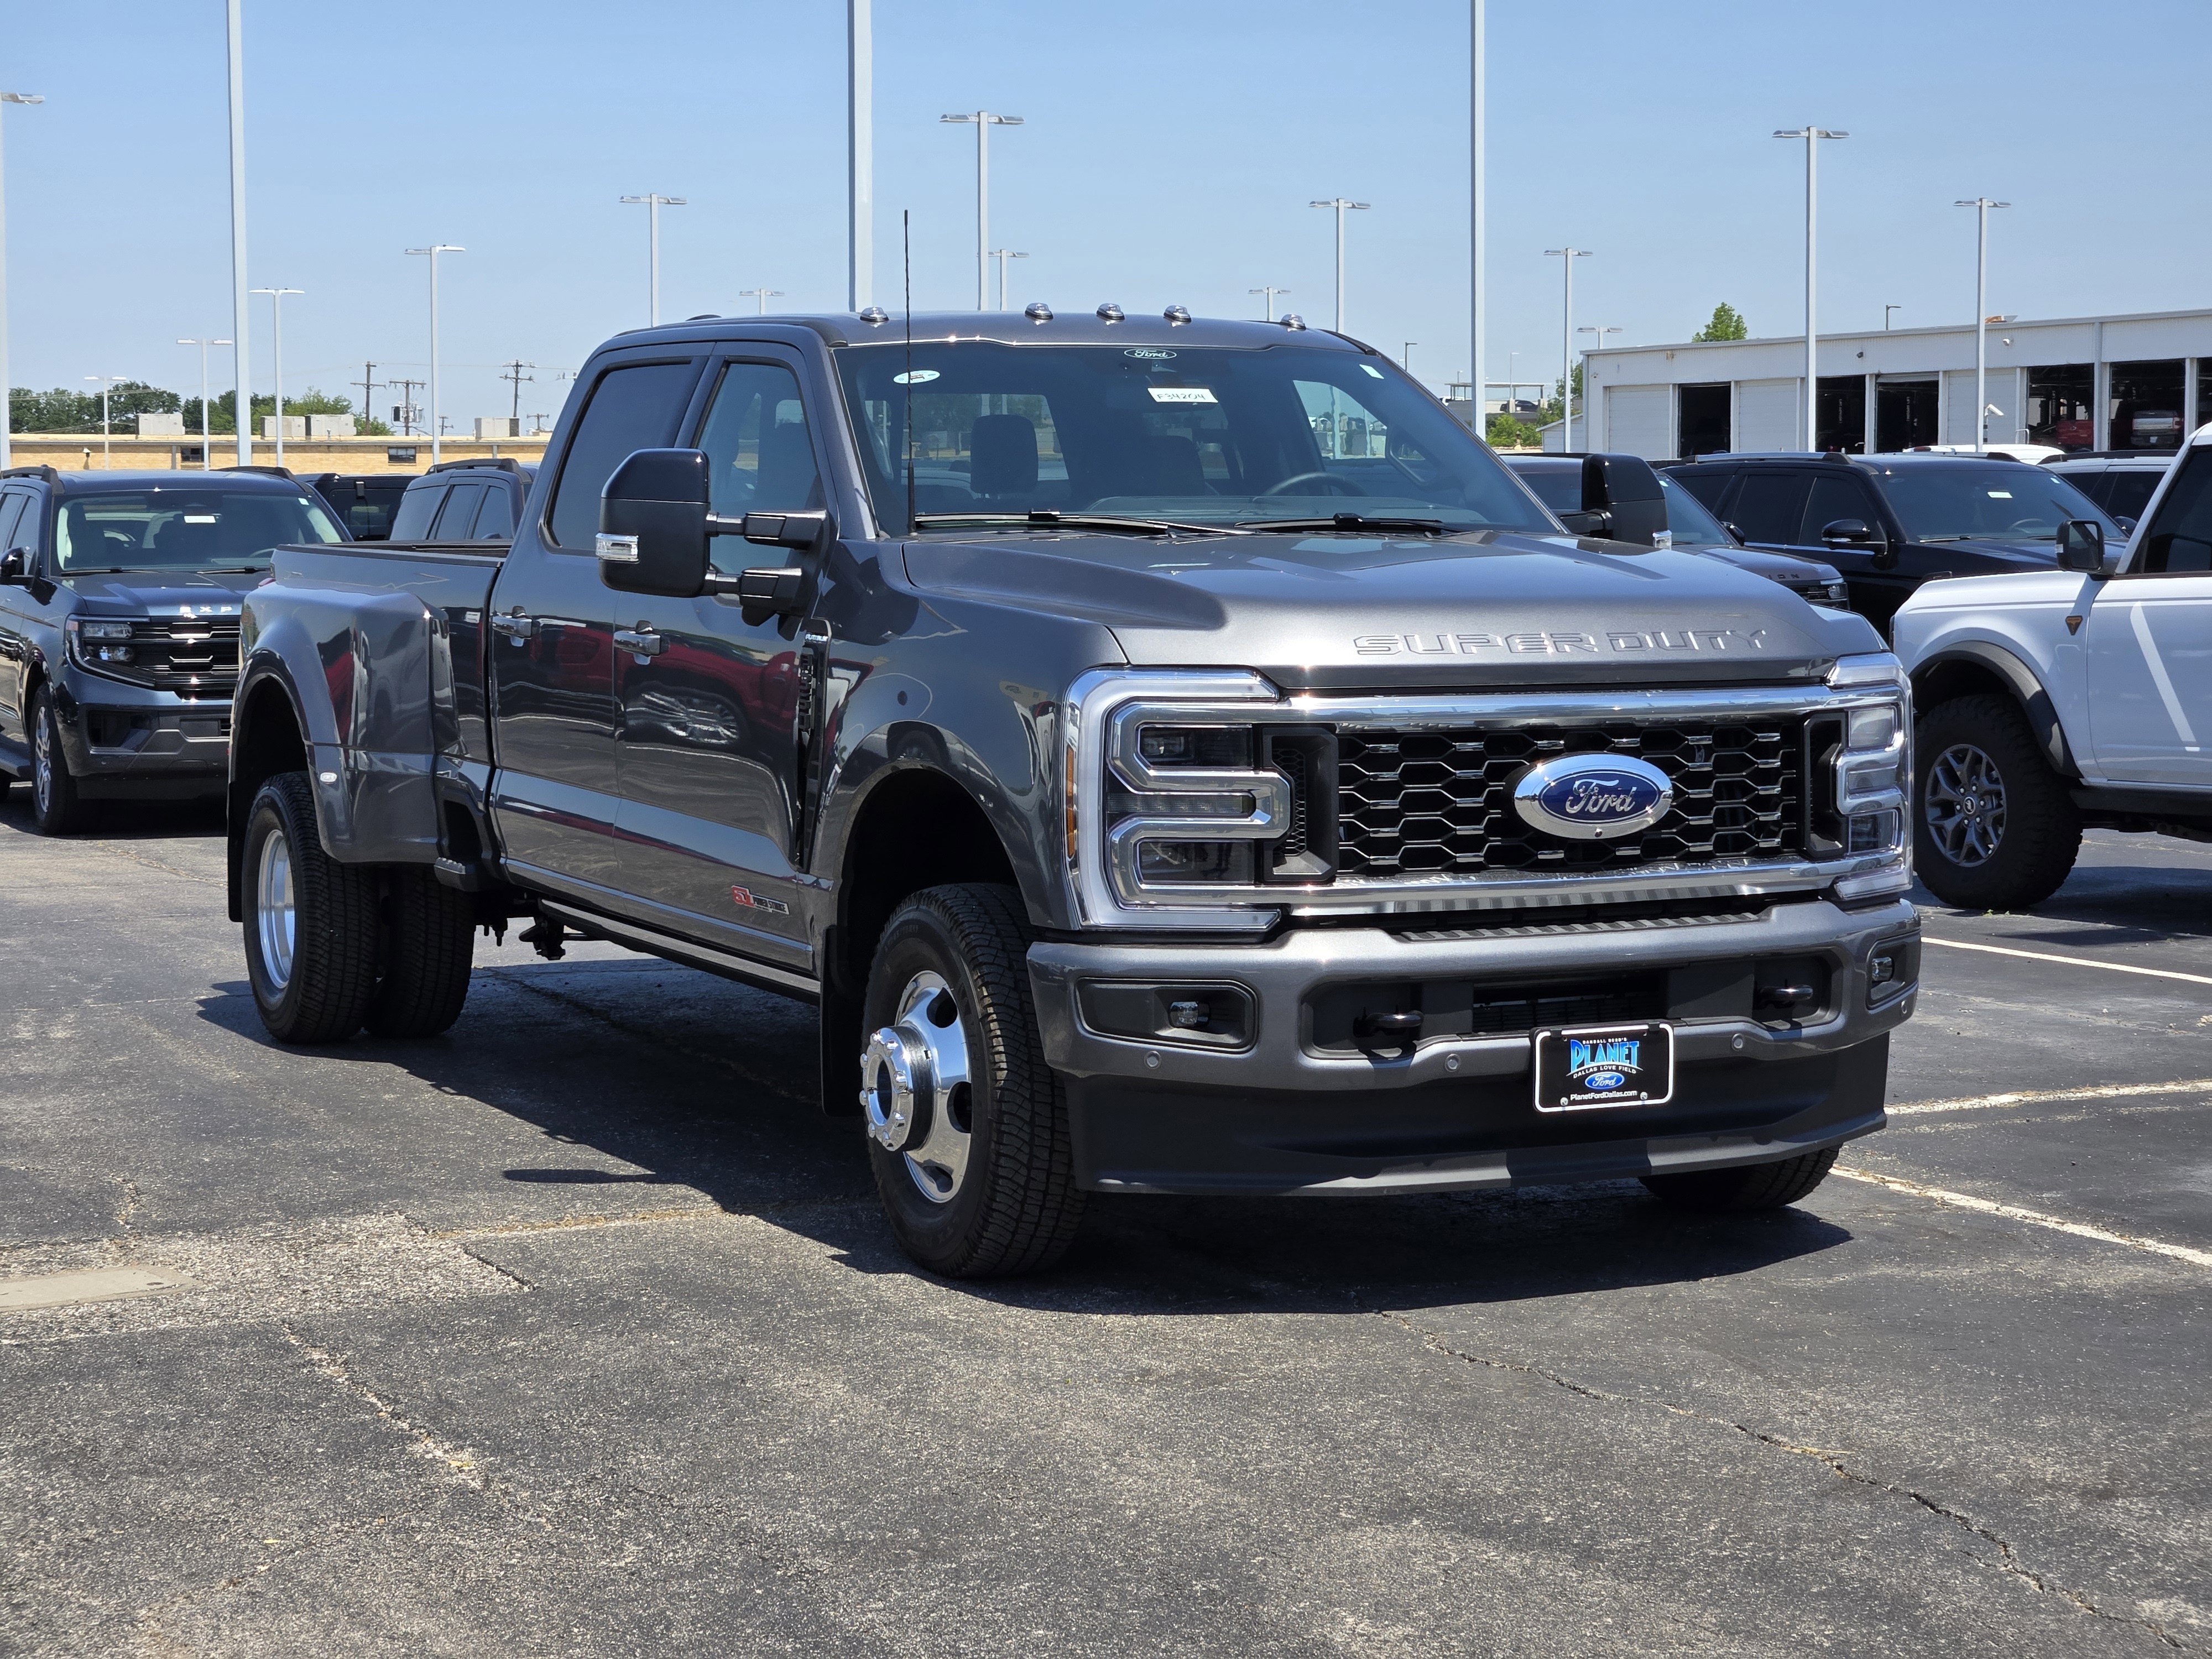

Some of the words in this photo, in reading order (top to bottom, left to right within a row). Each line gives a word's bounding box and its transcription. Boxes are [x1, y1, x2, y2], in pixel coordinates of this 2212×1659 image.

[1134, 349, 1168, 358] Ford
[1353, 632, 1598, 655] SUPER
[1606, 629, 1766, 653] DUTY
[1566, 779, 1637, 814] Ford
[1571, 1039, 1640, 1072] PLANET
[1573, 1067, 1598, 1079] DALLAS
[1619, 1065, 1637, 1074] FIELD
[1593, 1074, 1617, 1087] Ford
[1570, 1091, 1637, 1101] PlanetFordDallas.com
